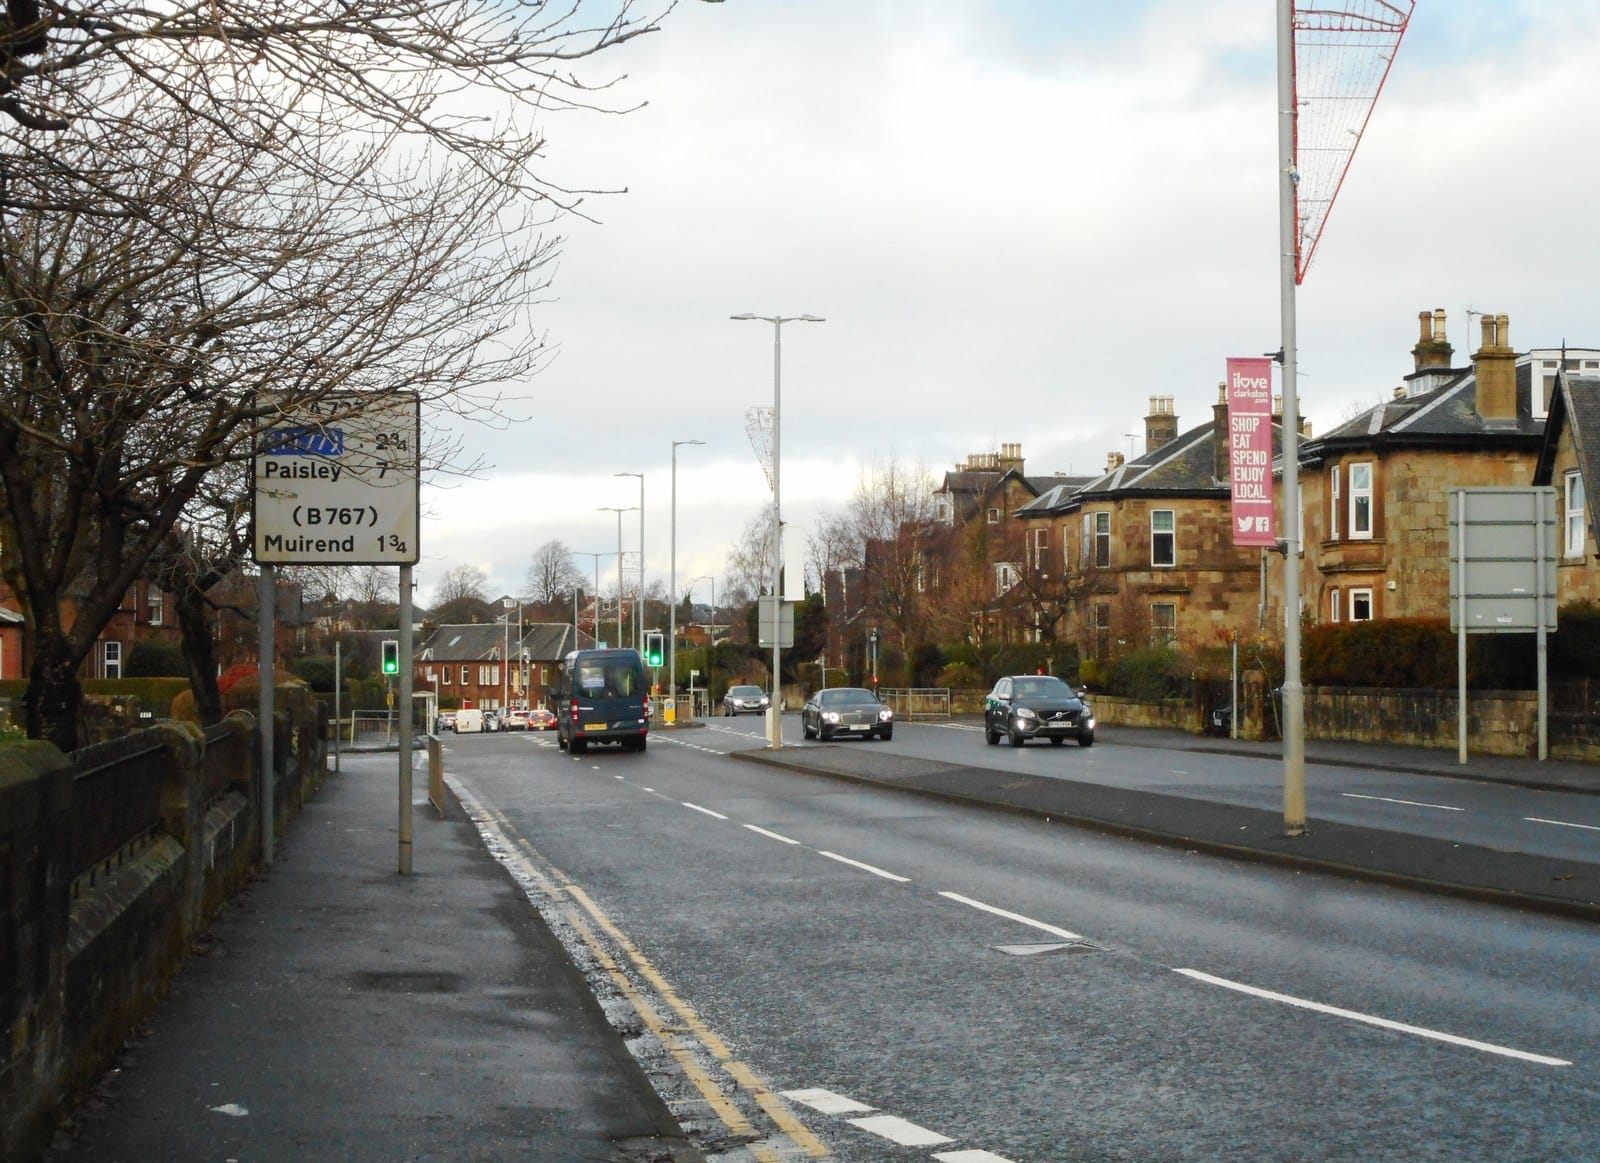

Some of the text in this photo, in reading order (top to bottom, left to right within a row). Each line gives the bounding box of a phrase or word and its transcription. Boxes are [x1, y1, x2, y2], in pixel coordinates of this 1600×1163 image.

[1232, 417, 1259, 432] SHOP
[1233, 434, 1251, 448] EAT
[1233, 450, 1267, 465] SPEND
[265, 461, 388, 482] Paisley 7
[1234, 467, 1265, 481] ENJOY
[264, 534, 354, 553] Muirend
